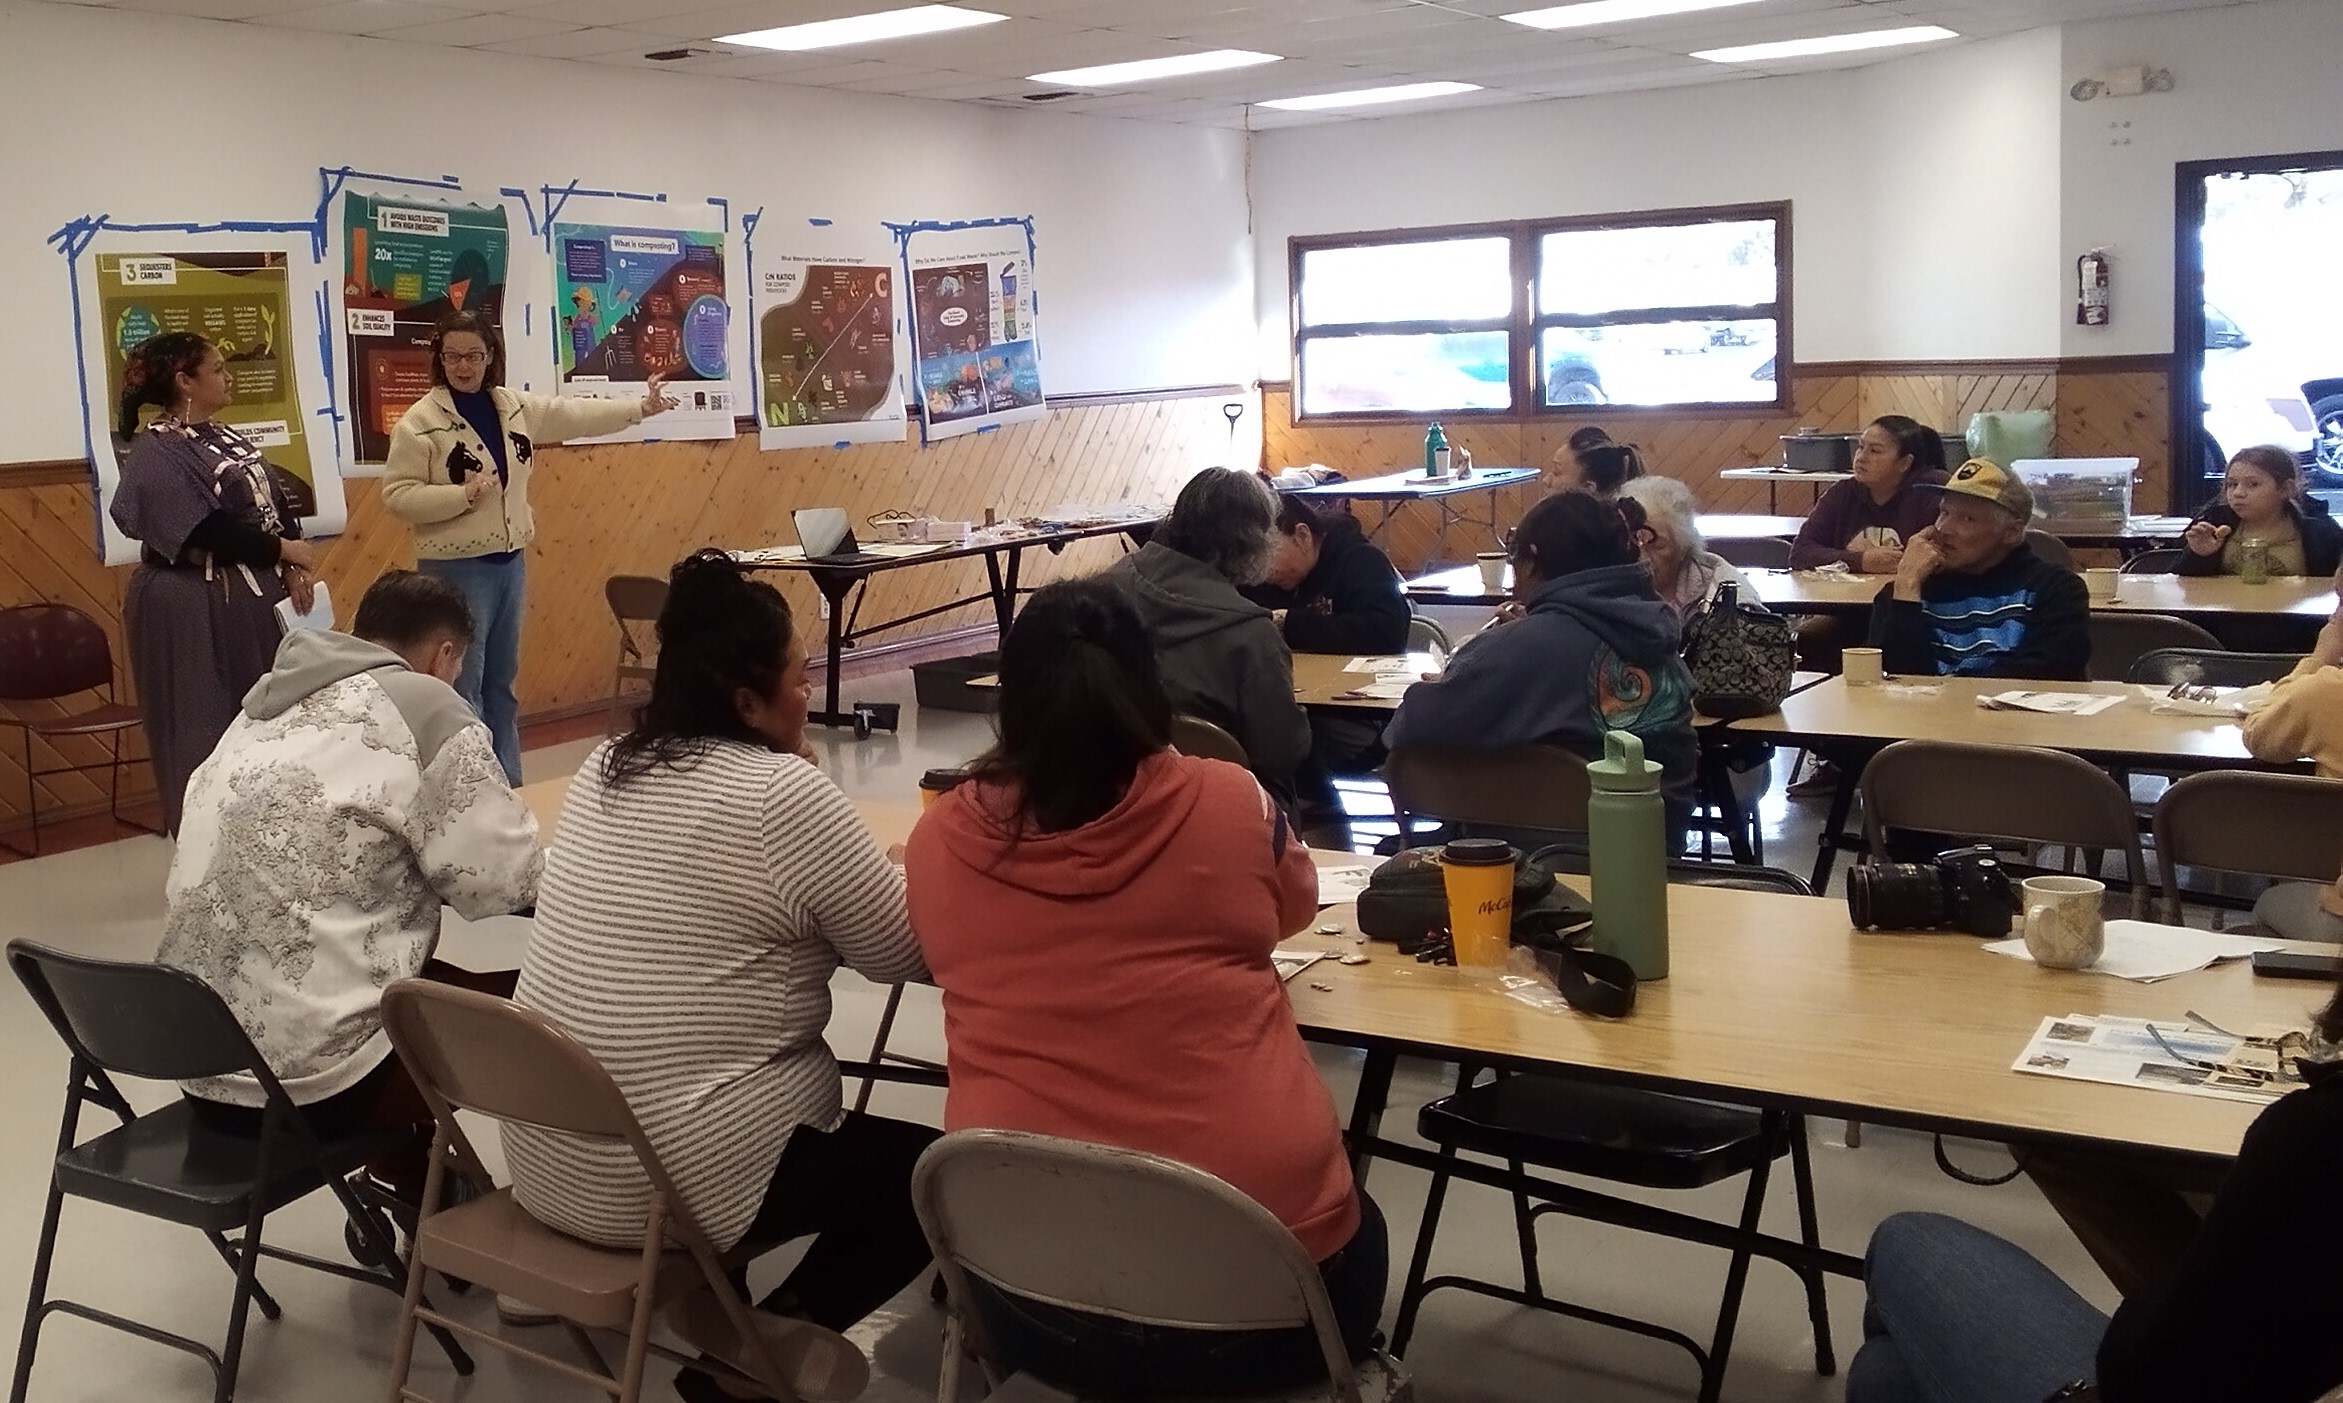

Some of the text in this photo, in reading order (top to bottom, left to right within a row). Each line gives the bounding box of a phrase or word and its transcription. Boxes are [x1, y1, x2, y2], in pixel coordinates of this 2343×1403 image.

[381, 211, 387, 228] 1
[407, 214, 421, 222] WASTE
[390, 221, 402, 229] WITH
[614, 239, 676, 251] What is composting?
[374, 247, 392, 261] 20x
[126, 264, 136, 281] 3
[139, 263, 172, 271] SEQUESTERS
[776, 273, 796, 281] RATIOS
[875, 272, 888, 297] C
[351, 313, 360, 330] 2
[362, 314, 385, 322] ENHANCES
[373, 323, 391, 331] QUALITY
[769, 402, 790, 426] N
[254, 425, 285, 435] COMMUNITY
[1478, 897, 1511, 915] McCa
